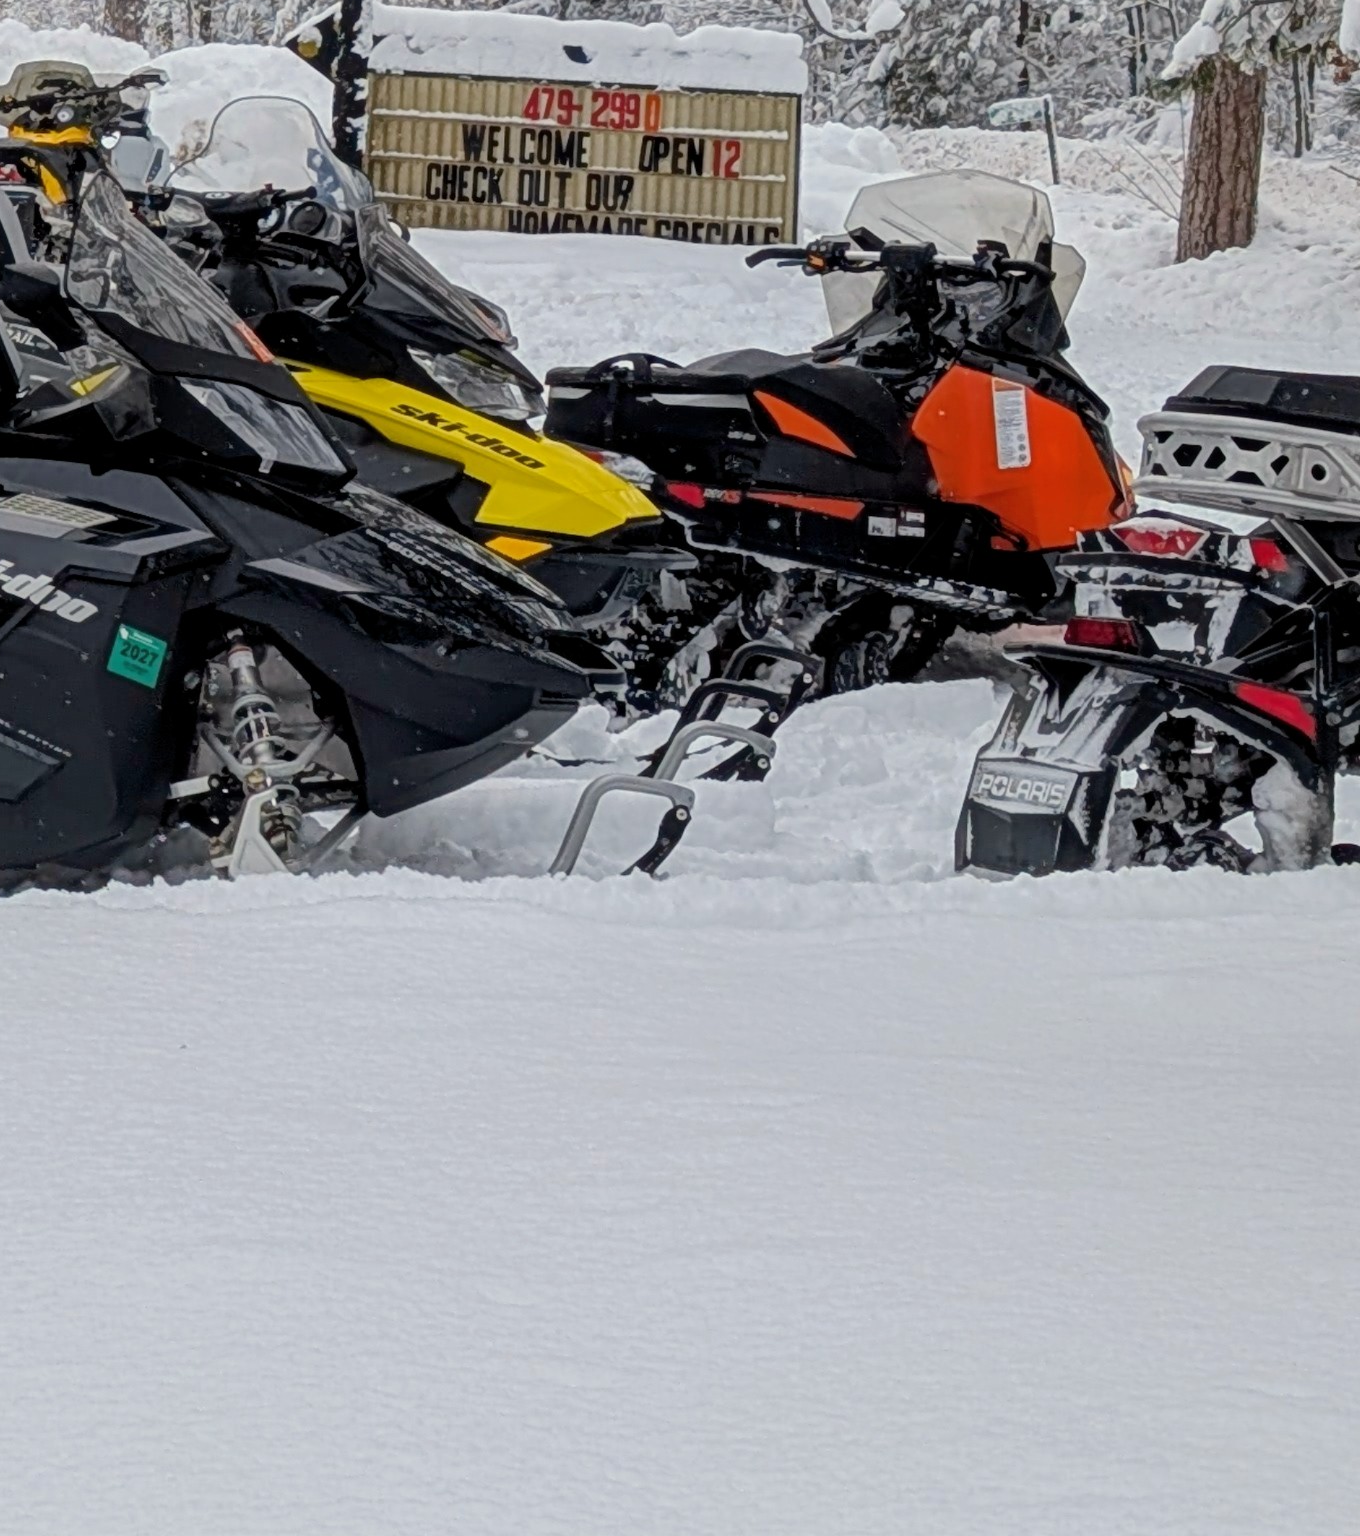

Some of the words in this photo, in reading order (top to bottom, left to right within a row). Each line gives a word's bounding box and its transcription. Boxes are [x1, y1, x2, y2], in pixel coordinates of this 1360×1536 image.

[462, 123, 591, 168] WELCOME
[638, 135, 705, 176] OPEN
[712, 139, 741, 178] 12
[425, 162, 504, 204] CHECK
[518, 169, 572, 208] OUT
[585, 174, 634, 211] OUR
[390, 403, 547, 470] ski-doo
[119, 641, 159, 666] 2027
[978, 772, 1066, 805] POLARIS
